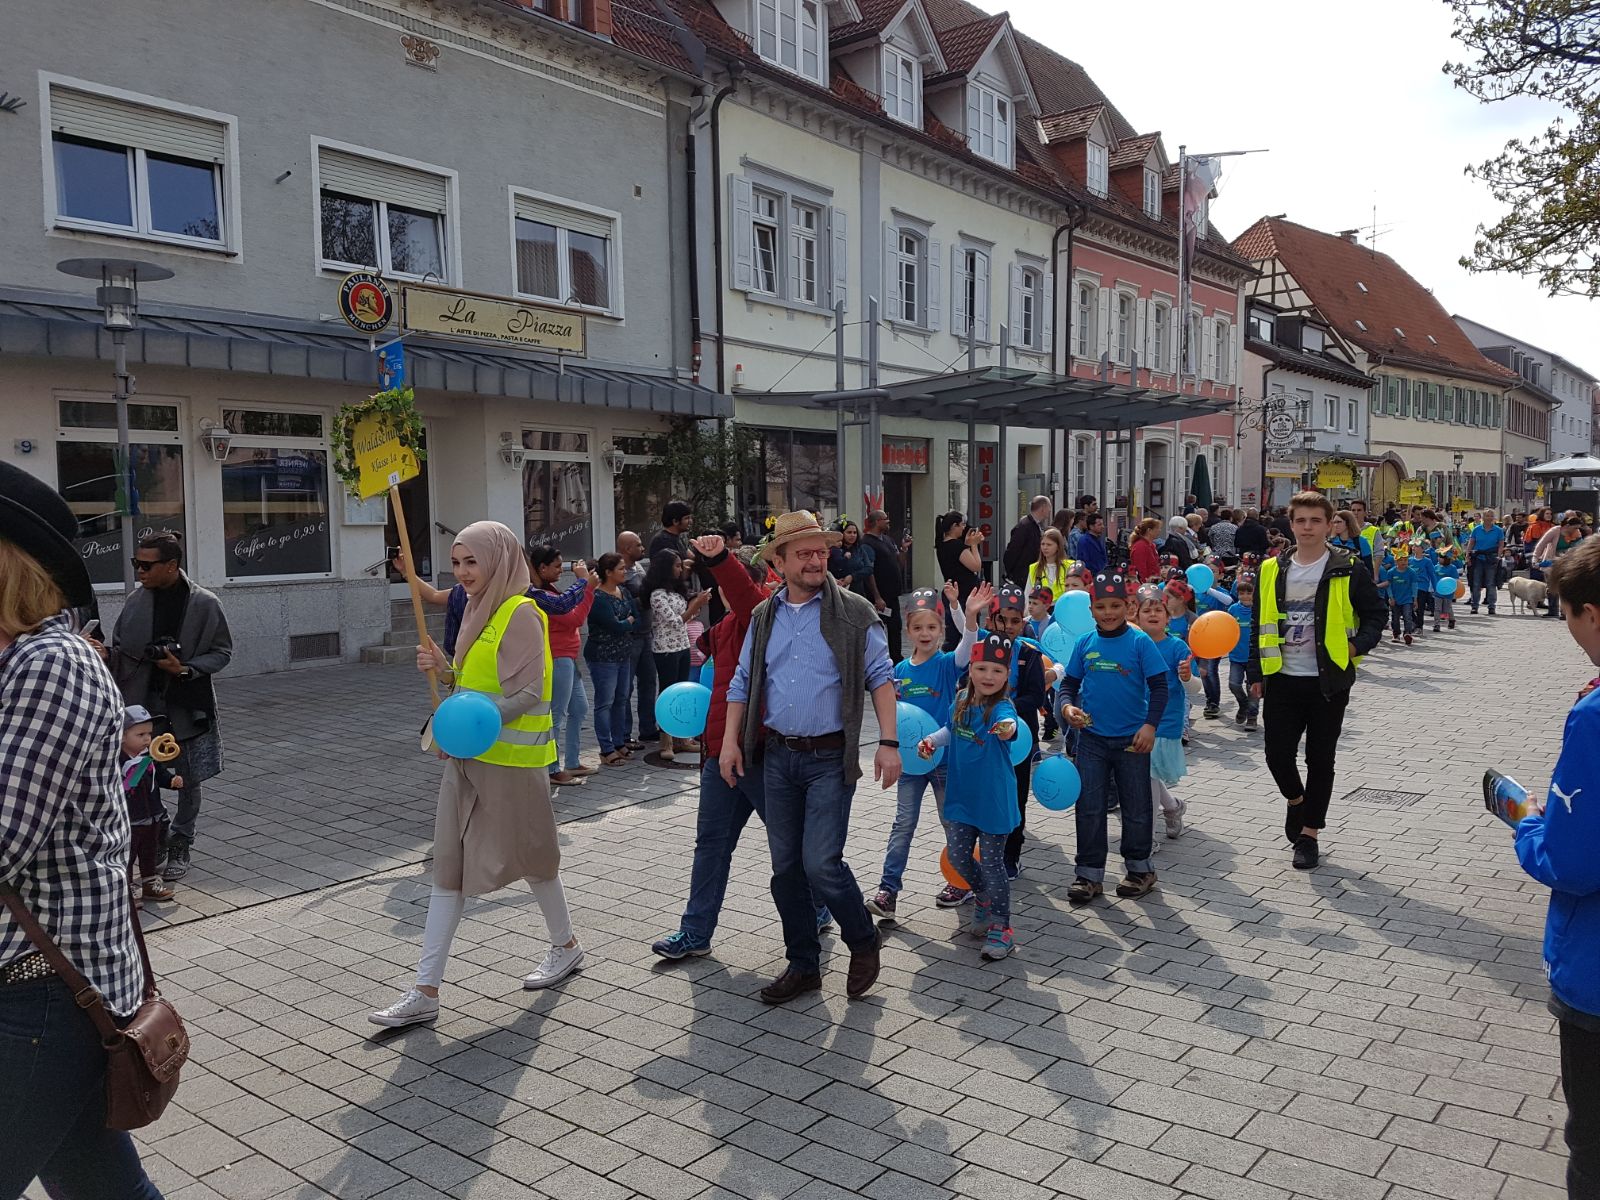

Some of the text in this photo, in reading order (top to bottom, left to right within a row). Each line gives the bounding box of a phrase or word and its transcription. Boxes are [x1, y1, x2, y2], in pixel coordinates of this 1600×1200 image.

[343, 274, 389, 298] PAULANER
[438, 298, 572, 338] La Piazza
[500, 334, 519, 342] PASTA
[21, 440, 32, 454] 9
[978, 446, 994, 558] Niebel
[234, 521, 325, 557] Caffee to go 0,99 €
[559, 530, 568, 542] go
[82, 541, 121, 559] Pizza
